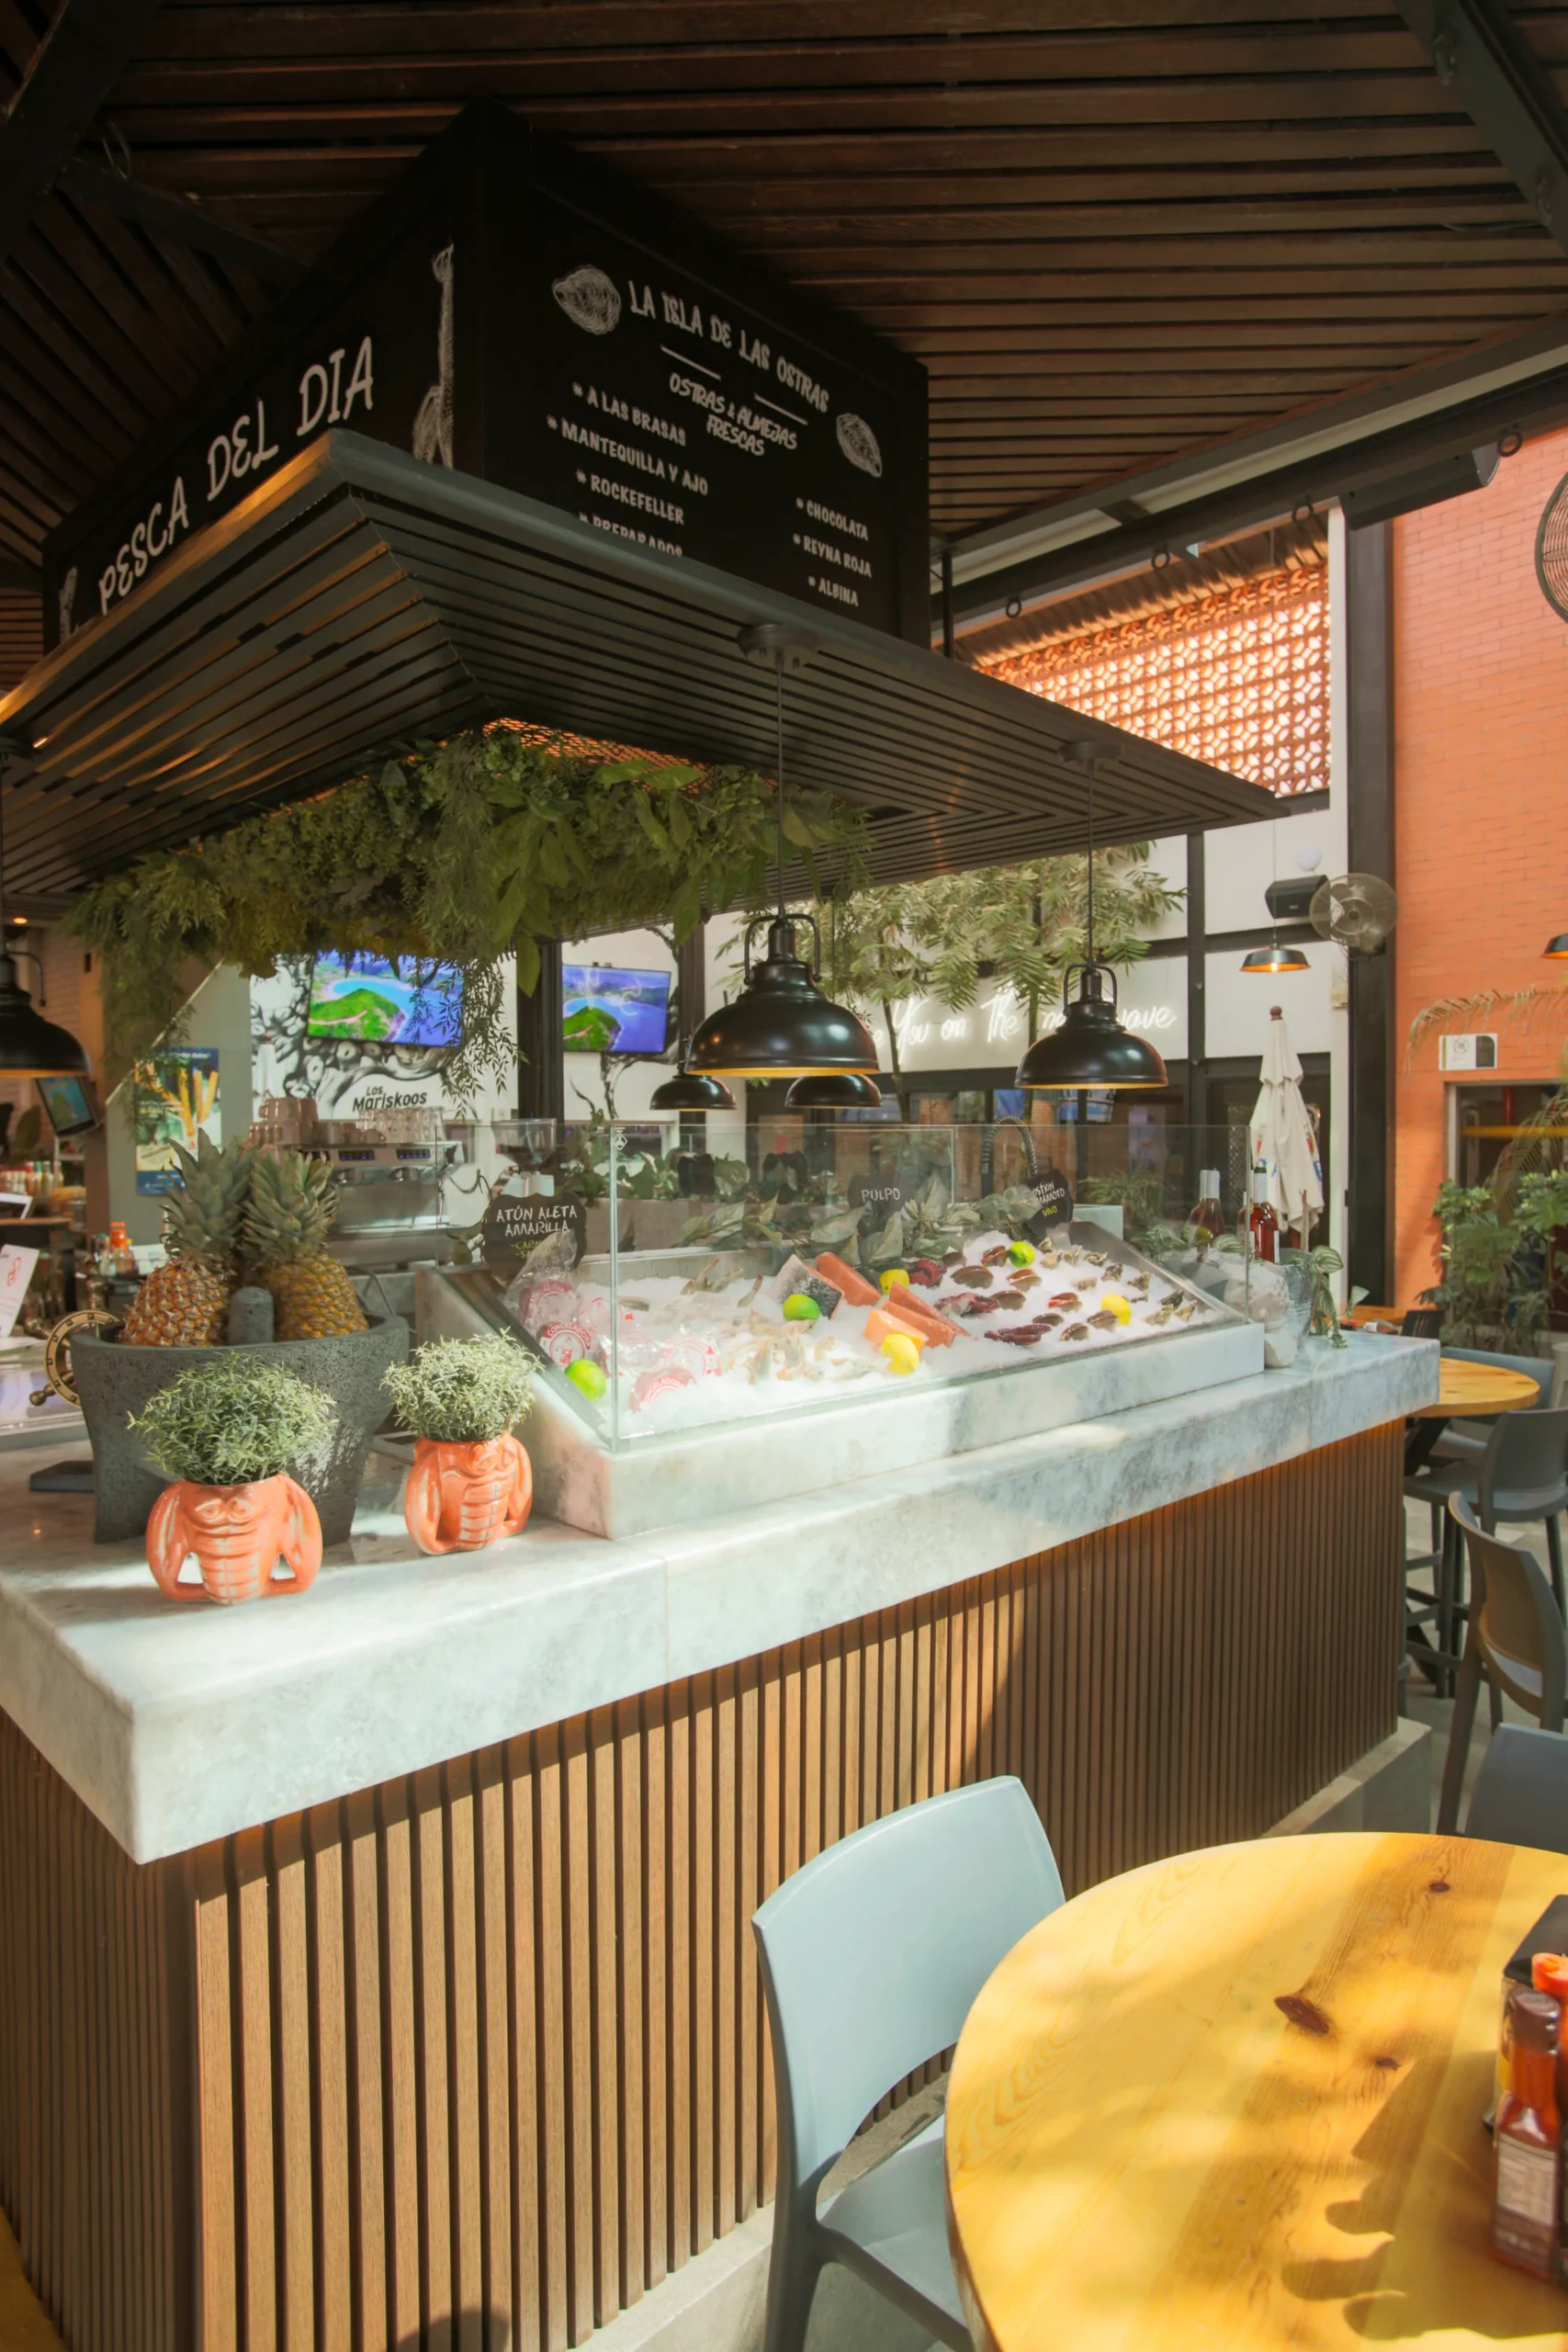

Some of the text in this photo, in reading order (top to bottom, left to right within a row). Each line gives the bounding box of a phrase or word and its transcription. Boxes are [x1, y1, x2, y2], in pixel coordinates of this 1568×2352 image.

[628, 280, 829, 413] LA ISLA DE LAS OSTRAS
[587, 386, 686, 447] A LAS BRASAS
[670, 372, 725, 413] OSTRAS
[737, 405, 798, 450] ALMEJAS
[562, 417, 708, 496] MANTEQUILLA Y AJO
[706, 413, 765, 457] FRESCAS
[99, 336, 373, 616] PESCA DEL DIA
[591, 474, 684, 526] ROCKEFELLER
[807, 499, 869, 541] CHOCOLATA
[804, 535, 872, 579] REYNA ROJA
[818, 577, 859, 607] ALBINA
[941, 1015, 965, 1040] on
[1041, 1011, 1066, 1030] ne
[1117, 1005, 1178, 1030] ave
[497, 1205, 578, 1223] ATÚN ALETA
[862, 1187, 900, 1202] PULPO
